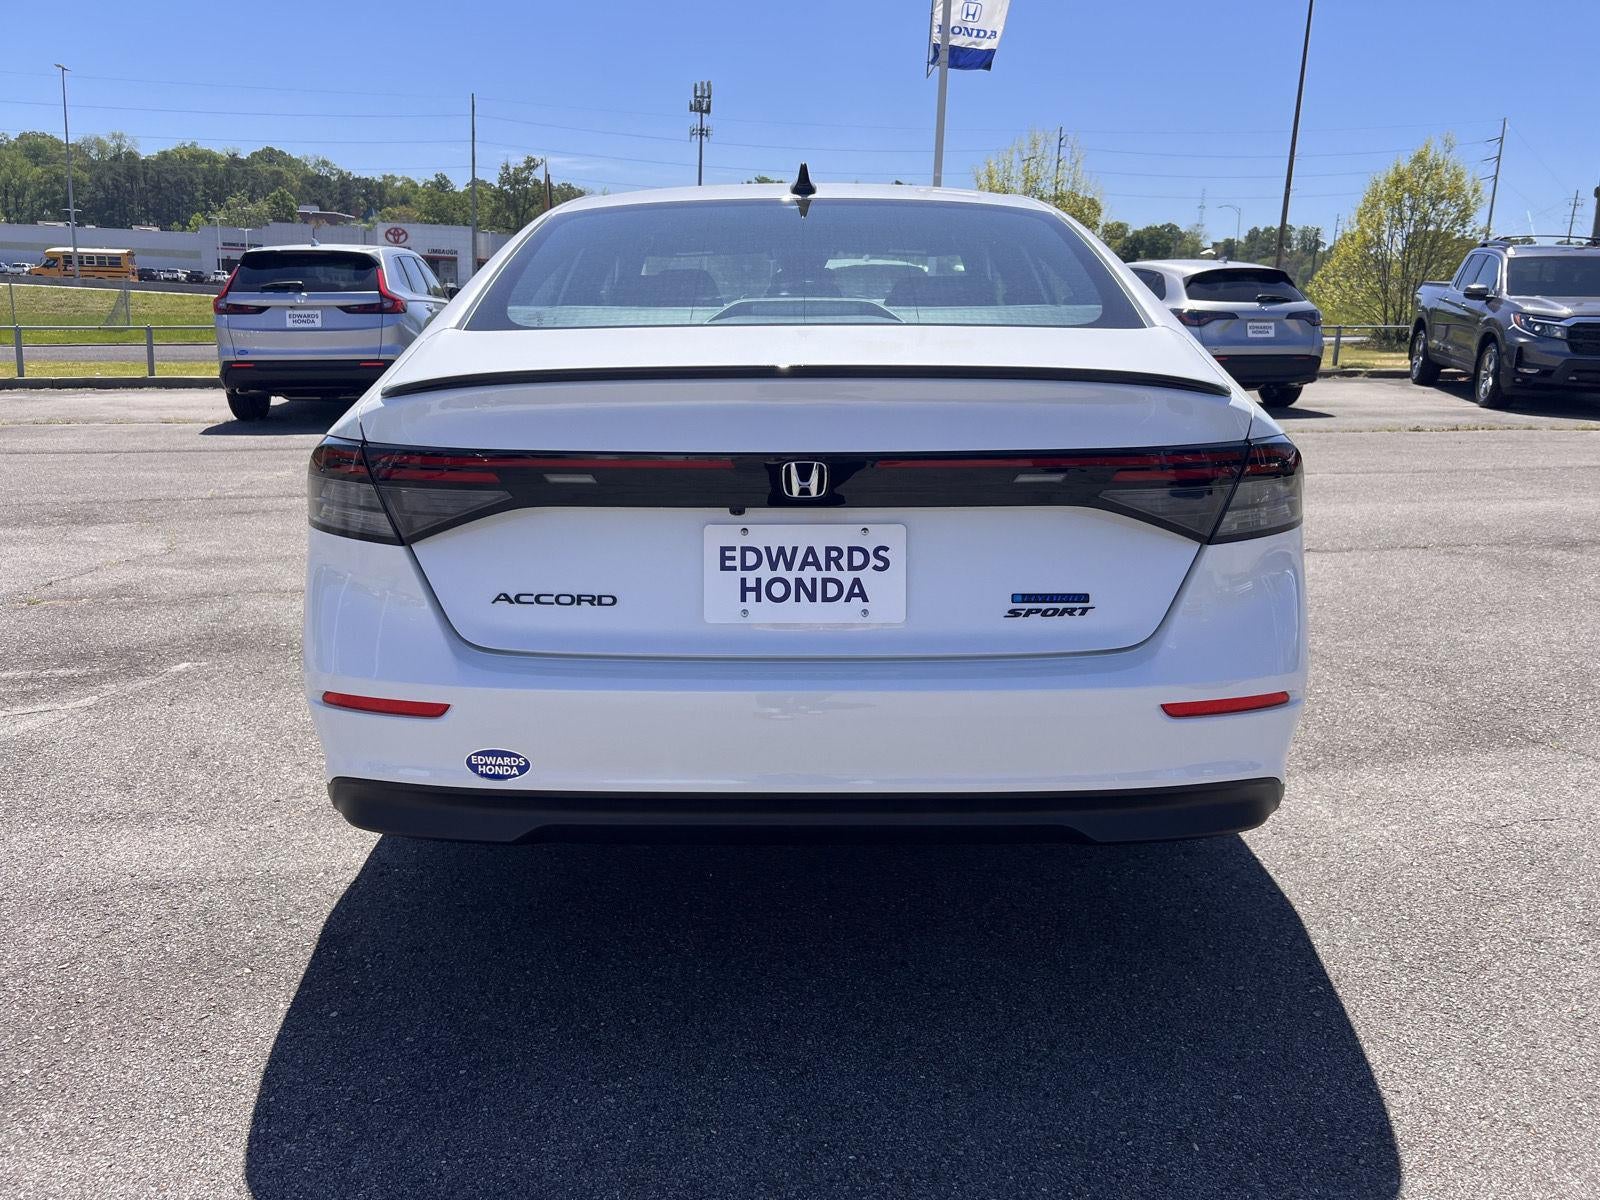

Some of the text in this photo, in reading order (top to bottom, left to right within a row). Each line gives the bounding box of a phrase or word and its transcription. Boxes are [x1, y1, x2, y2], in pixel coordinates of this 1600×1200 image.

[719, 545, 891, 572] EDWARDS
[740, 576, 870, 603] HONDA
[491, 592, 618, 606] ACCORD
[1003, 606, 1096, 618] SPORT
[471, 755, 526, 766] EDWARDS
[478, 765, 520, 775] HONDA
